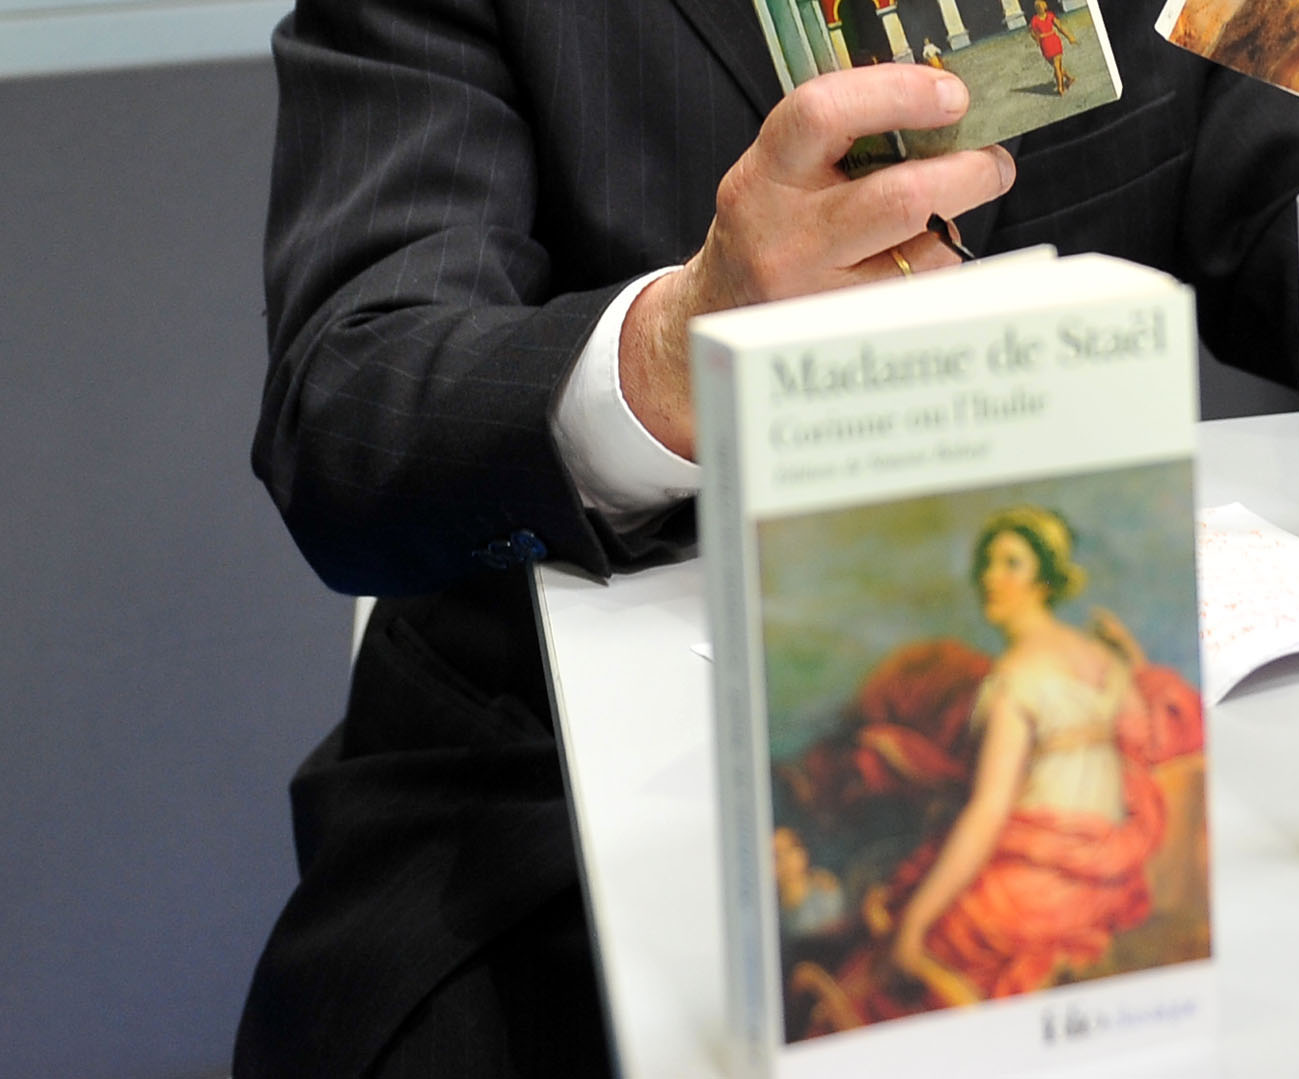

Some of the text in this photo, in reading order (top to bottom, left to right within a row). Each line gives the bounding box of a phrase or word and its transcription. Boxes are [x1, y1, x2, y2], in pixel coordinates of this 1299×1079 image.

[769, 307, 1168, 397] Madame de Staël
